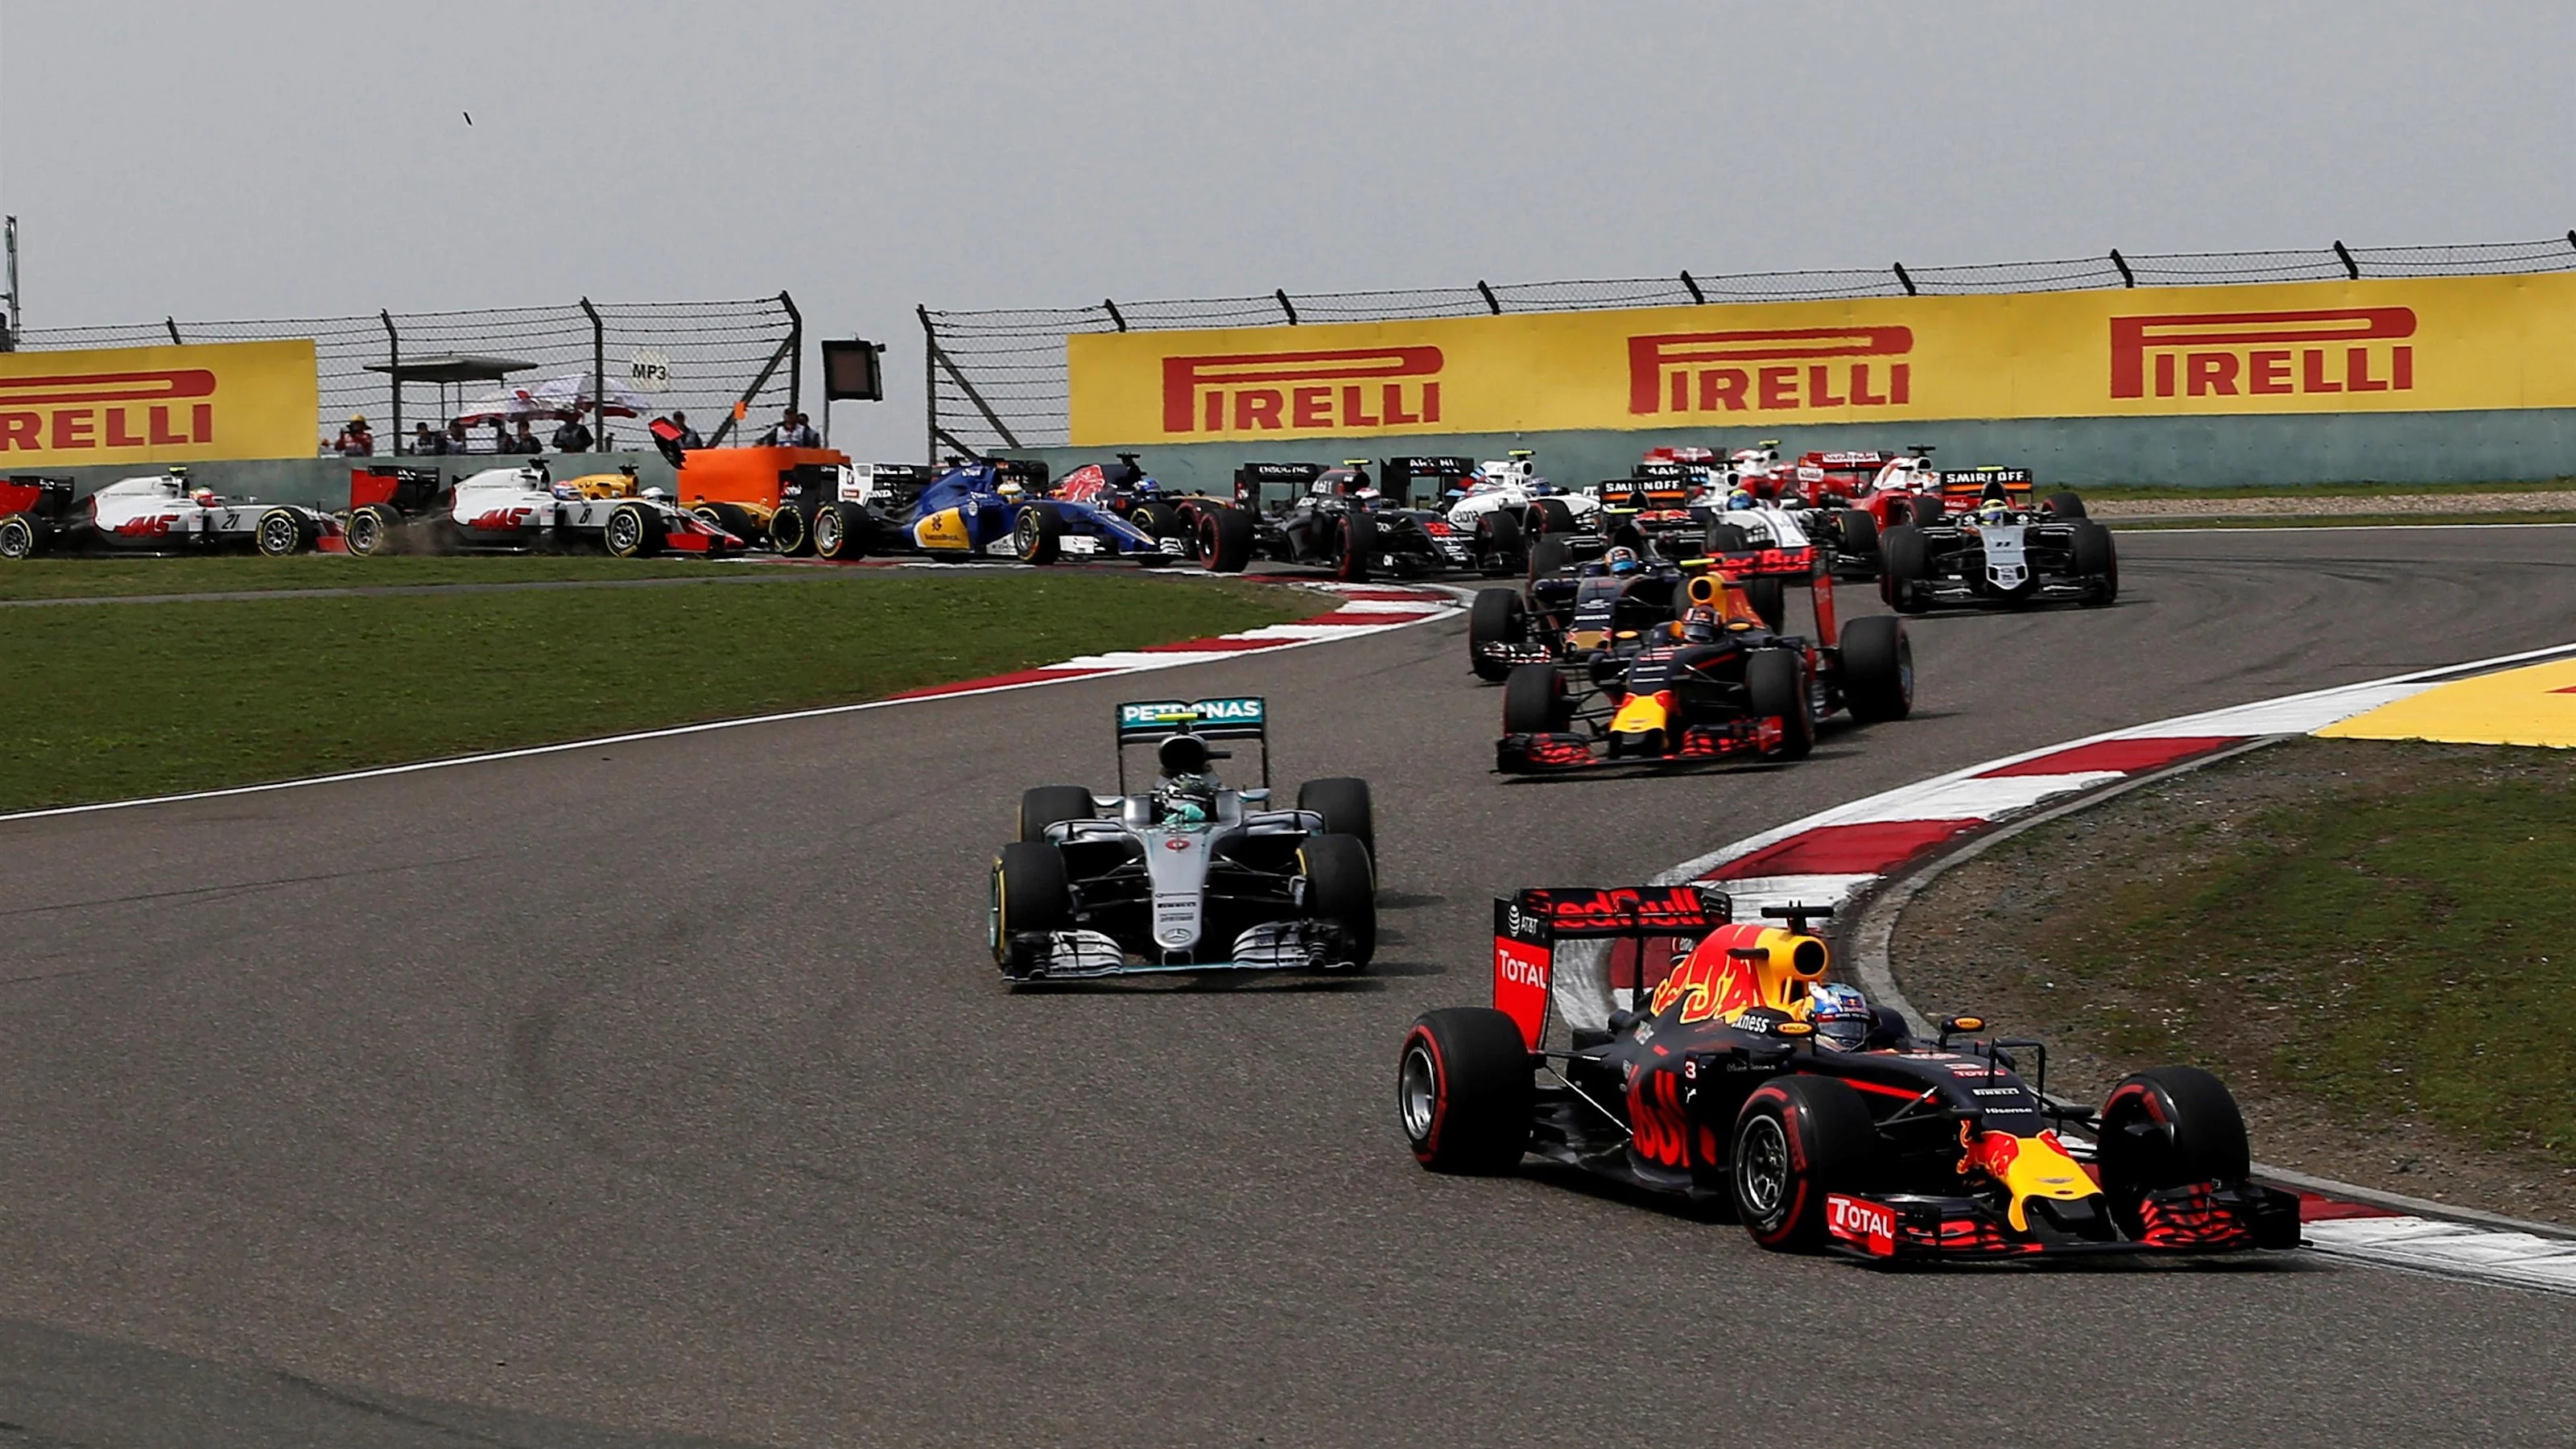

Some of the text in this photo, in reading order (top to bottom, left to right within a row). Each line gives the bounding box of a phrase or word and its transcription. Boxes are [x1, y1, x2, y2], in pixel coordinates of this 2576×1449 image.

[633, 364, 666, 380] MP3
[1163, 346, 1443, 432] PIRELLI
[1628, 325, 1913, 415] PIRELLI
[2110, 307, 2417, 398] PIRELLI
[0, 369, 216, 452] RELLI
[221, 513, 240, 529] 21
[1685, 1061, 1696, 1079] 3
